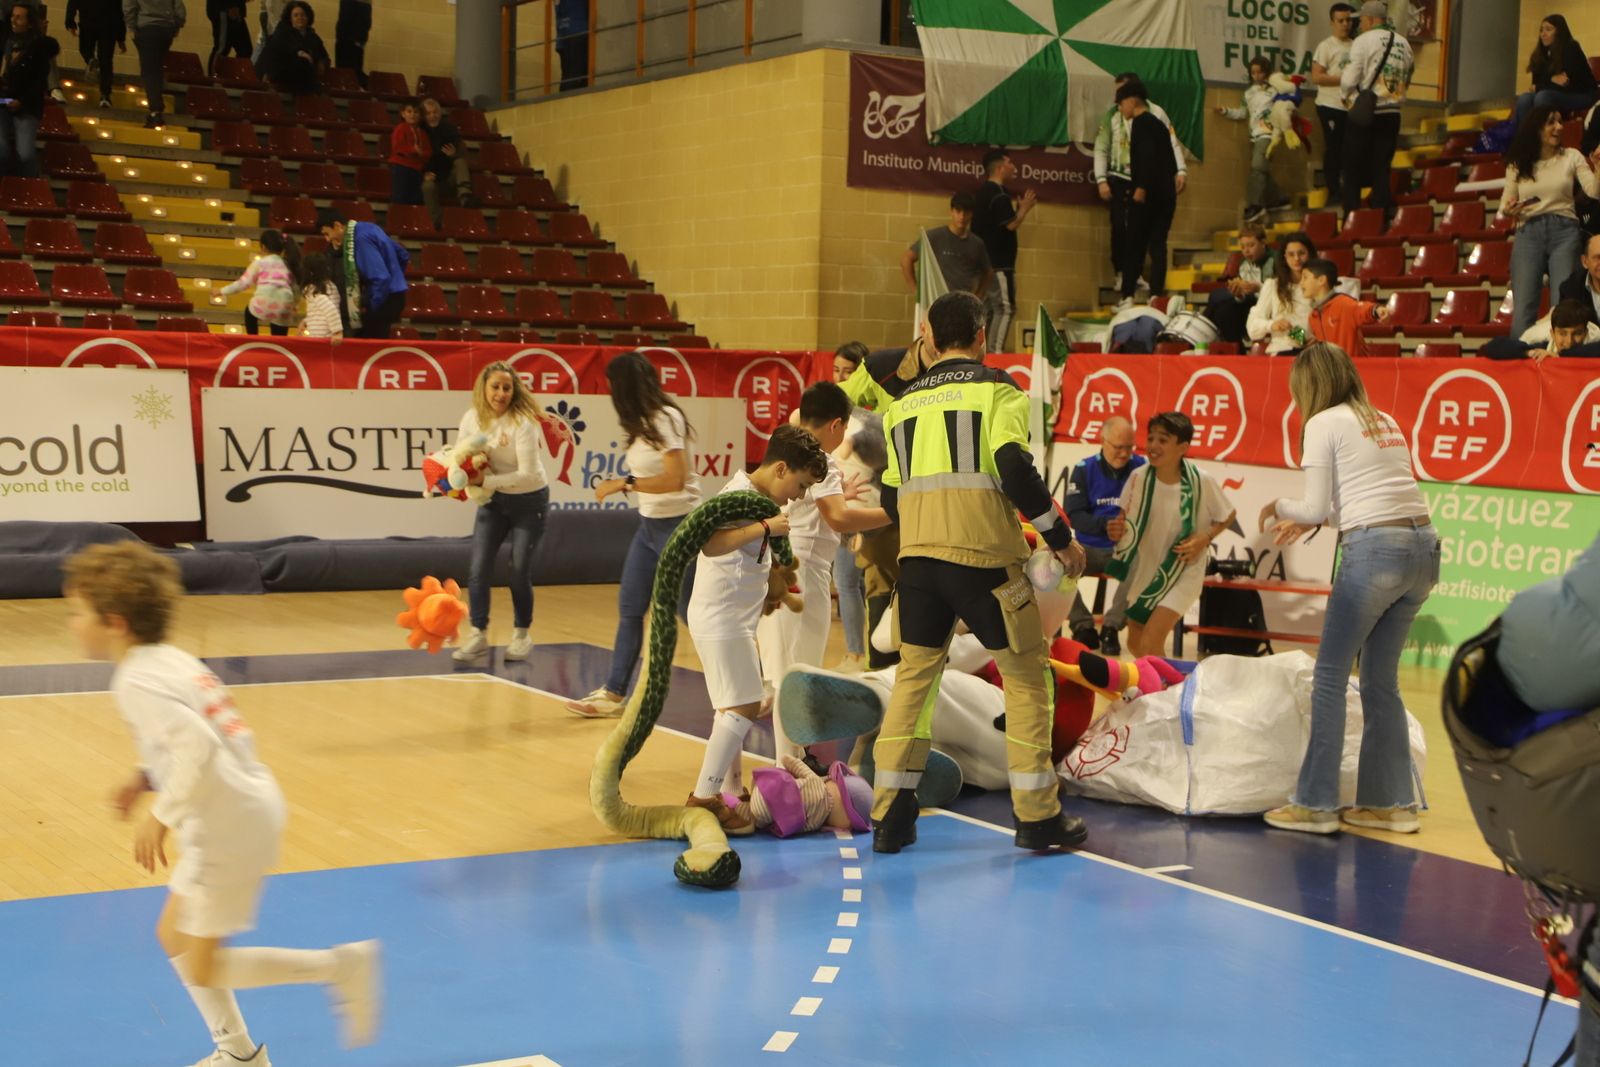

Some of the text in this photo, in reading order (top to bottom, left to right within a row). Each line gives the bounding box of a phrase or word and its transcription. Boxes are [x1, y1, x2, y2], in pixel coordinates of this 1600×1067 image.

[1227, 0, 1310, 26] LOCOS
[1246, 24, 1279, 41] DEL
[862, 150, 924, 171] Instituto
[1021, 163, 1084, 184] Deportes
[238, 366, 288, 386] RF
[379, 369, 428, 389] RF
[752, 376, 791, 395] RF
[1088, 392, 1125, 414] RF
[1191, 394, 1230, 417] RF
[1438, 400, 1491, 427] RF
[0, 423, 126, 476] cold
[1430, 435, 1488, 461] EF
[1, 478, 130, 497] yond the cold
[1423, 484, 1574, 532] vázquez
